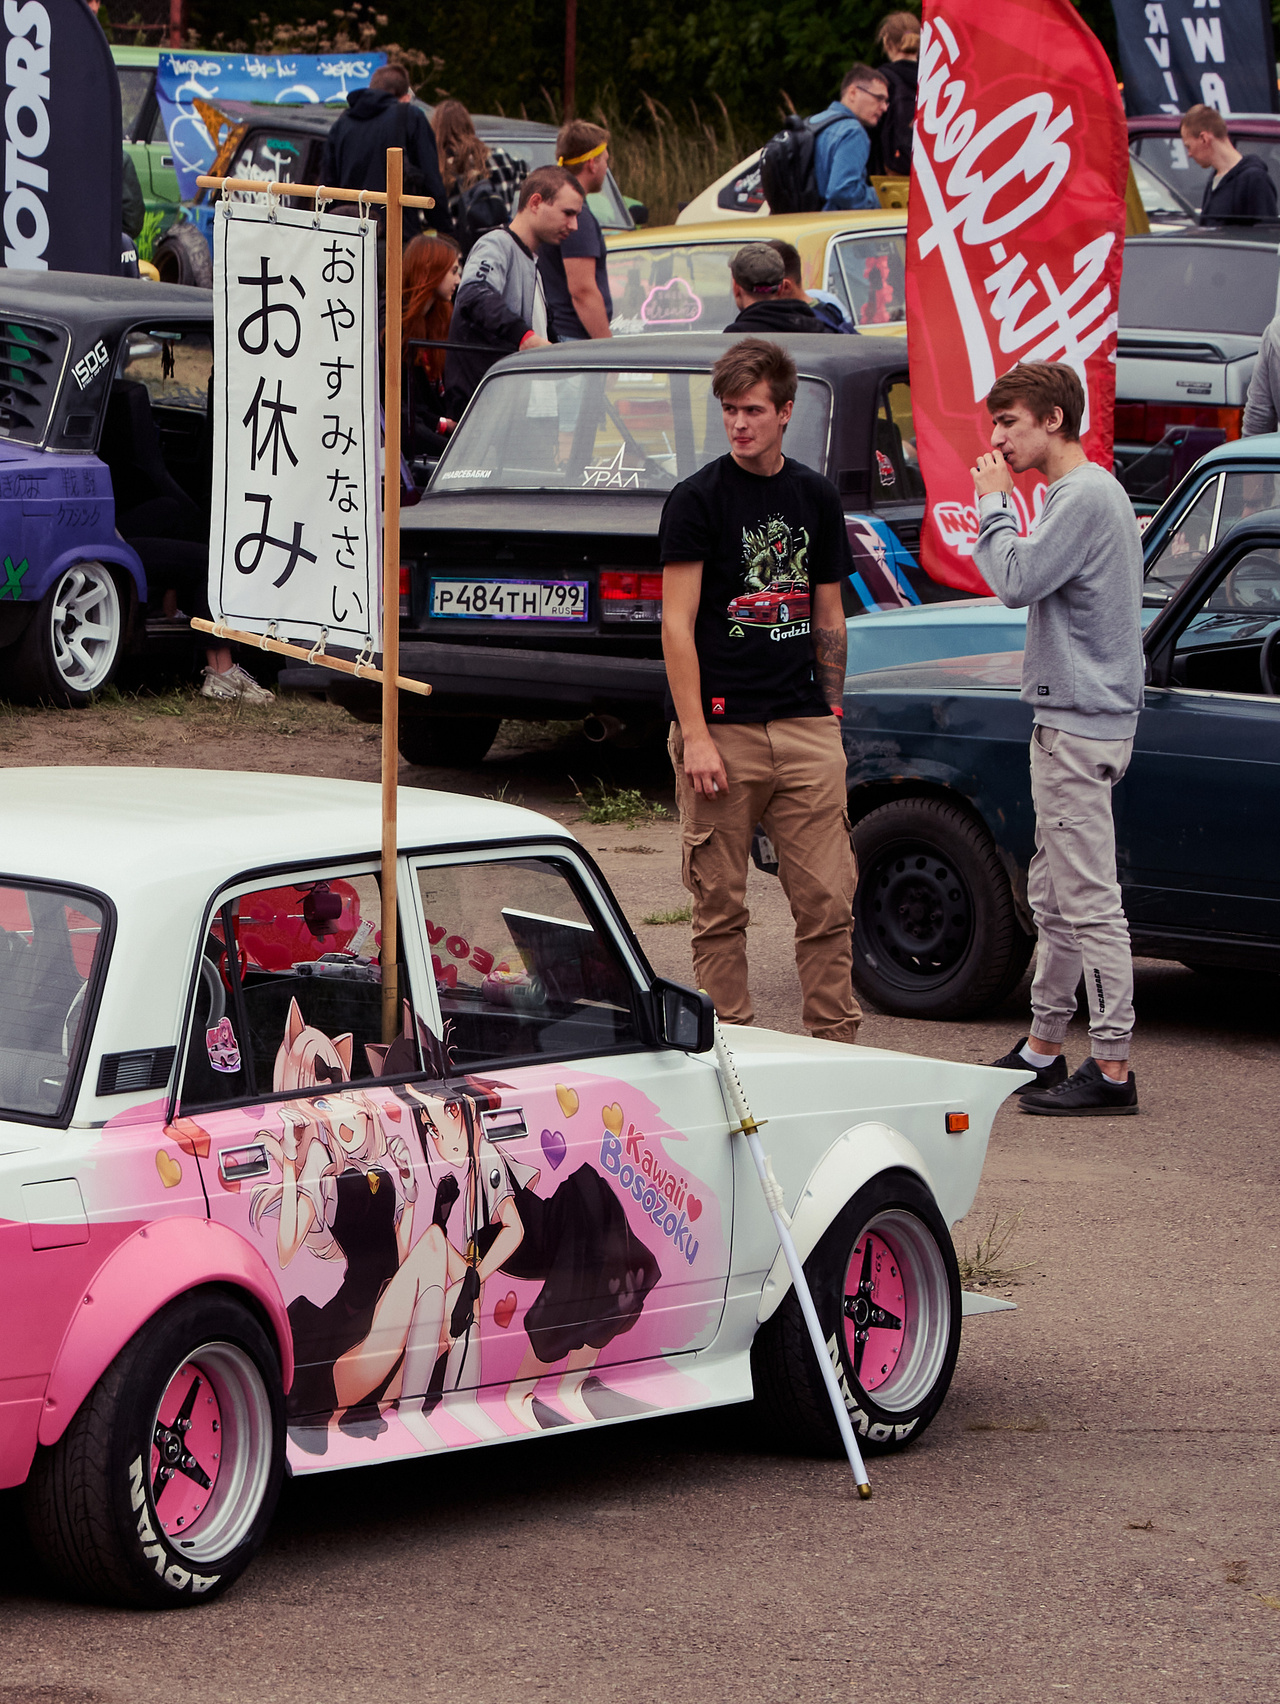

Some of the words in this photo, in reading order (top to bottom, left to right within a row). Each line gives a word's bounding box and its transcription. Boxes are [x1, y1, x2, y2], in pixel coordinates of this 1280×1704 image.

[234, 256, 318, 589] お休み
[320, 239, 364, 624] おやすみなさい
[582, 470, 640, 488] УРАЛ
[440, 585, 537, 614] Р484ТН
[543, 585, 580, 607] 799
[551, 607, 570, 615] RUS
[600, 1129, 700, 1266] Bosozoku
[625, 1122, 689, 1211] Kawaii
[128, 1454, 222, 1593] ADVAN
